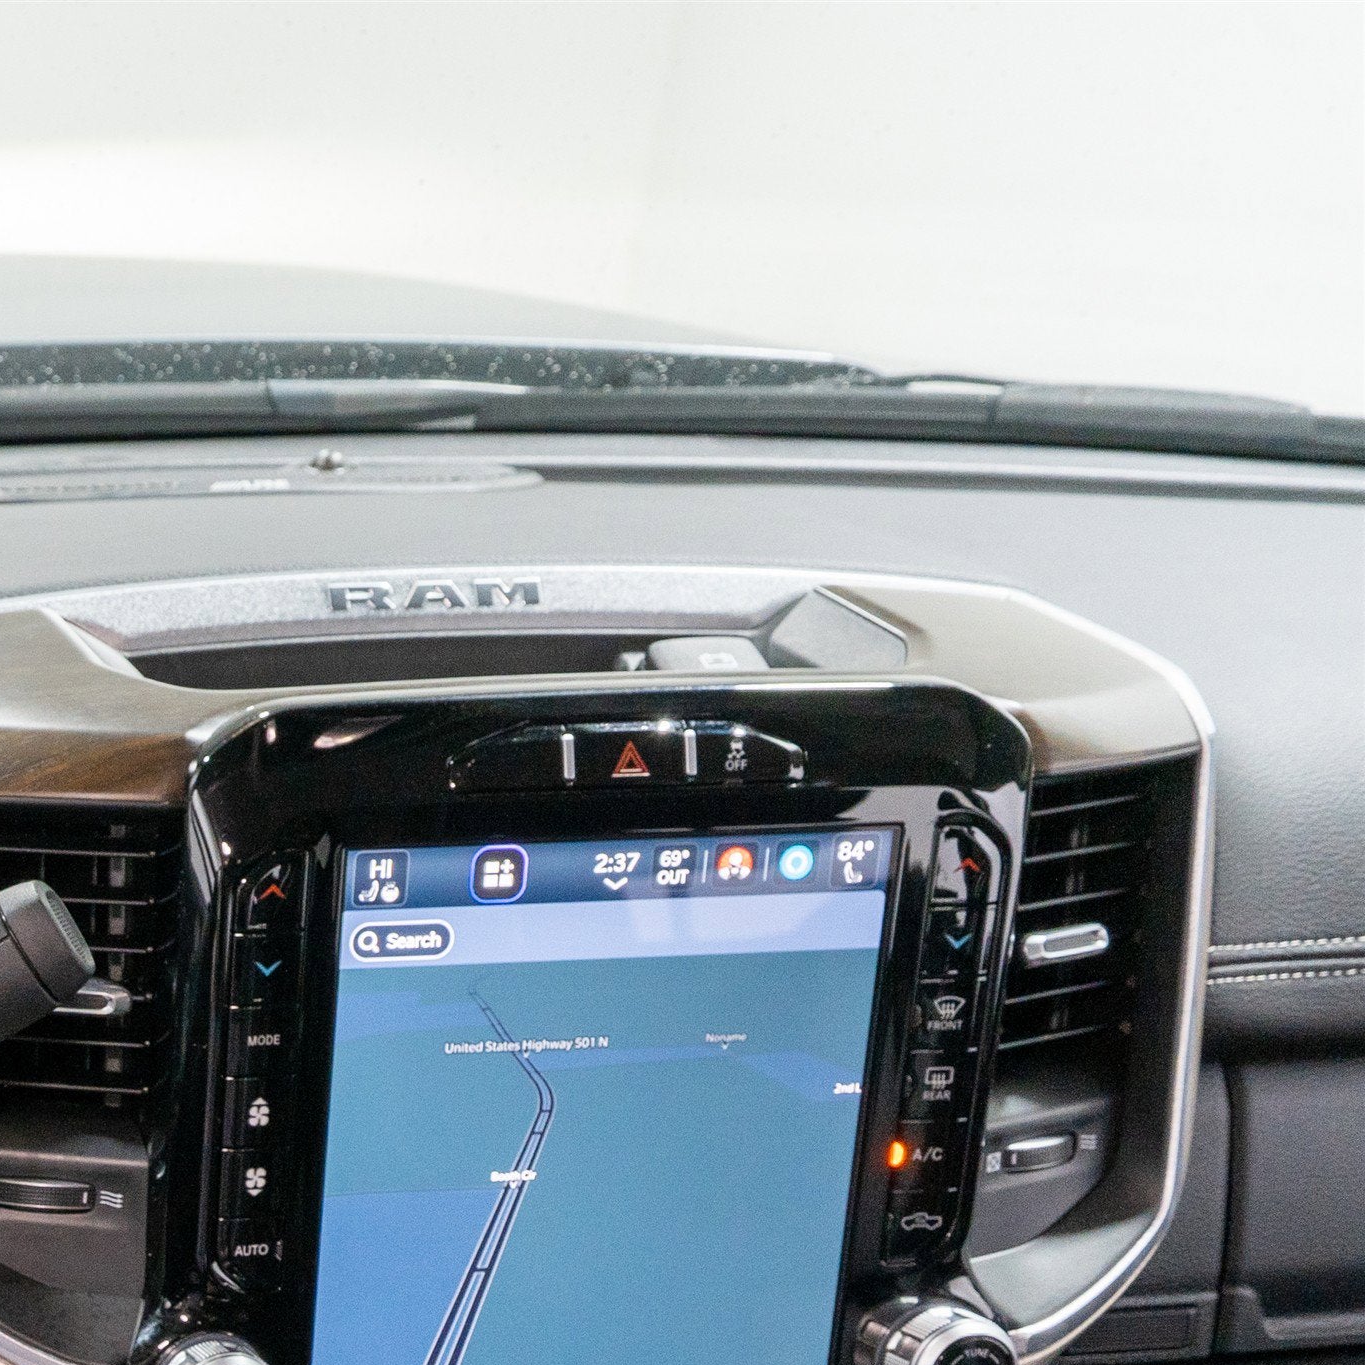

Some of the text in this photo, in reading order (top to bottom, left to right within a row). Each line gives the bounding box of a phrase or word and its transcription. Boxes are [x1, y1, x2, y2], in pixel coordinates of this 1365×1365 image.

[327, 577, 543, 611] RAM
[725, 759, 748, 772] OFF
[659, 848, 691, 868] 69°
[837, 839, 875, 861] 84°
[369, 859, 393, 879] HI
[593, 852, 641, 874] 2:37
[656, 869, 690, 886] OUT
[385, 930, 442, 950] Search
[926, 1019, 963, 1032] FRONT
[247, 1034, 281, 1047] MODE
[444, 1036, 609, 1054] United States Highway 501 N
[922, 1088, 951, 1101] REAR
[912, 1146, 943, 1162] A/C
[234, 1244, 269, 1257] AUTO
